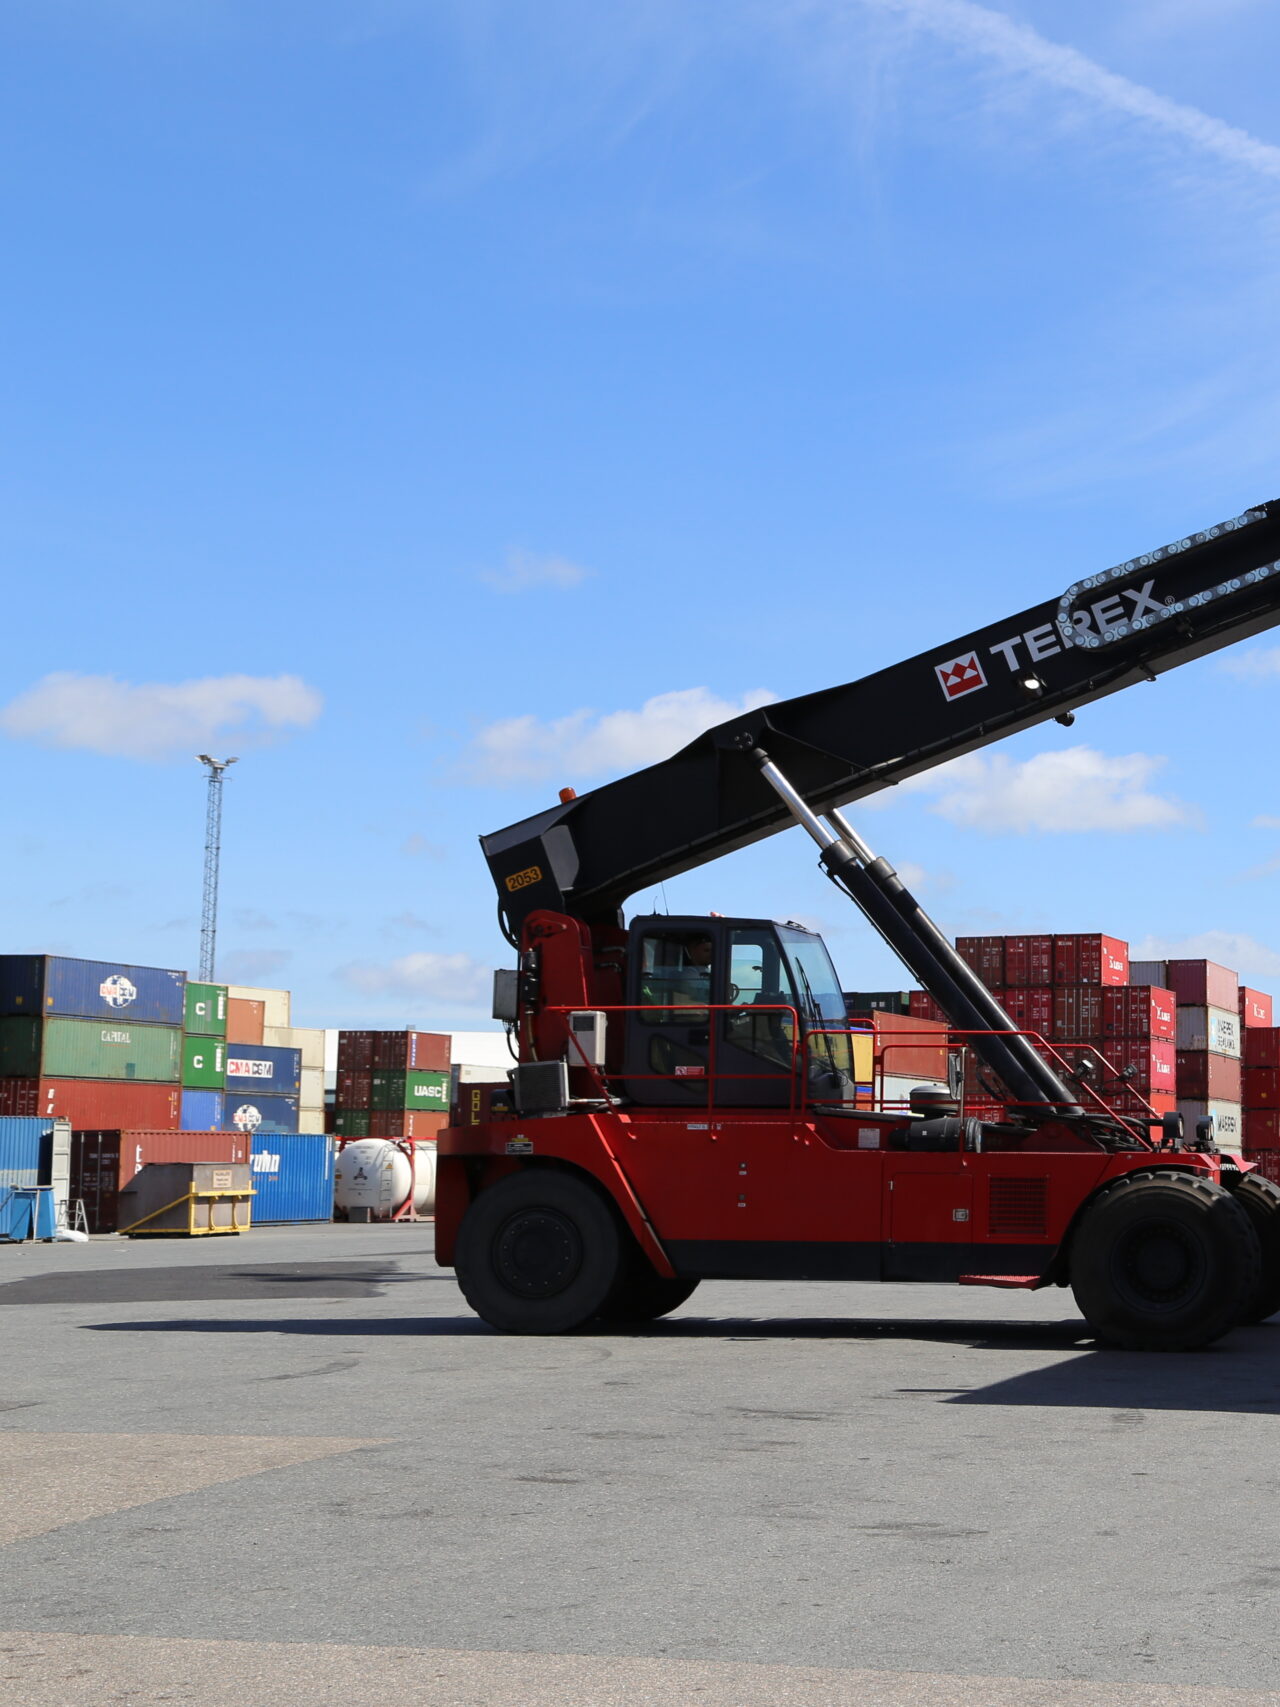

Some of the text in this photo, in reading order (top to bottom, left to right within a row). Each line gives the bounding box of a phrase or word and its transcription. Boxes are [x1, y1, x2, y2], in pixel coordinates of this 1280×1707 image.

[989, 579, 1168, 673] TEREX
[508, 868, 540, 890] 2053
[101, 1030, 131, 1043] CAPITAL
[228, 1060, 251, 1075] CMA
[414, 1084, 442, 1098] UASC
[471, 1089, 481, 1125] GOL
